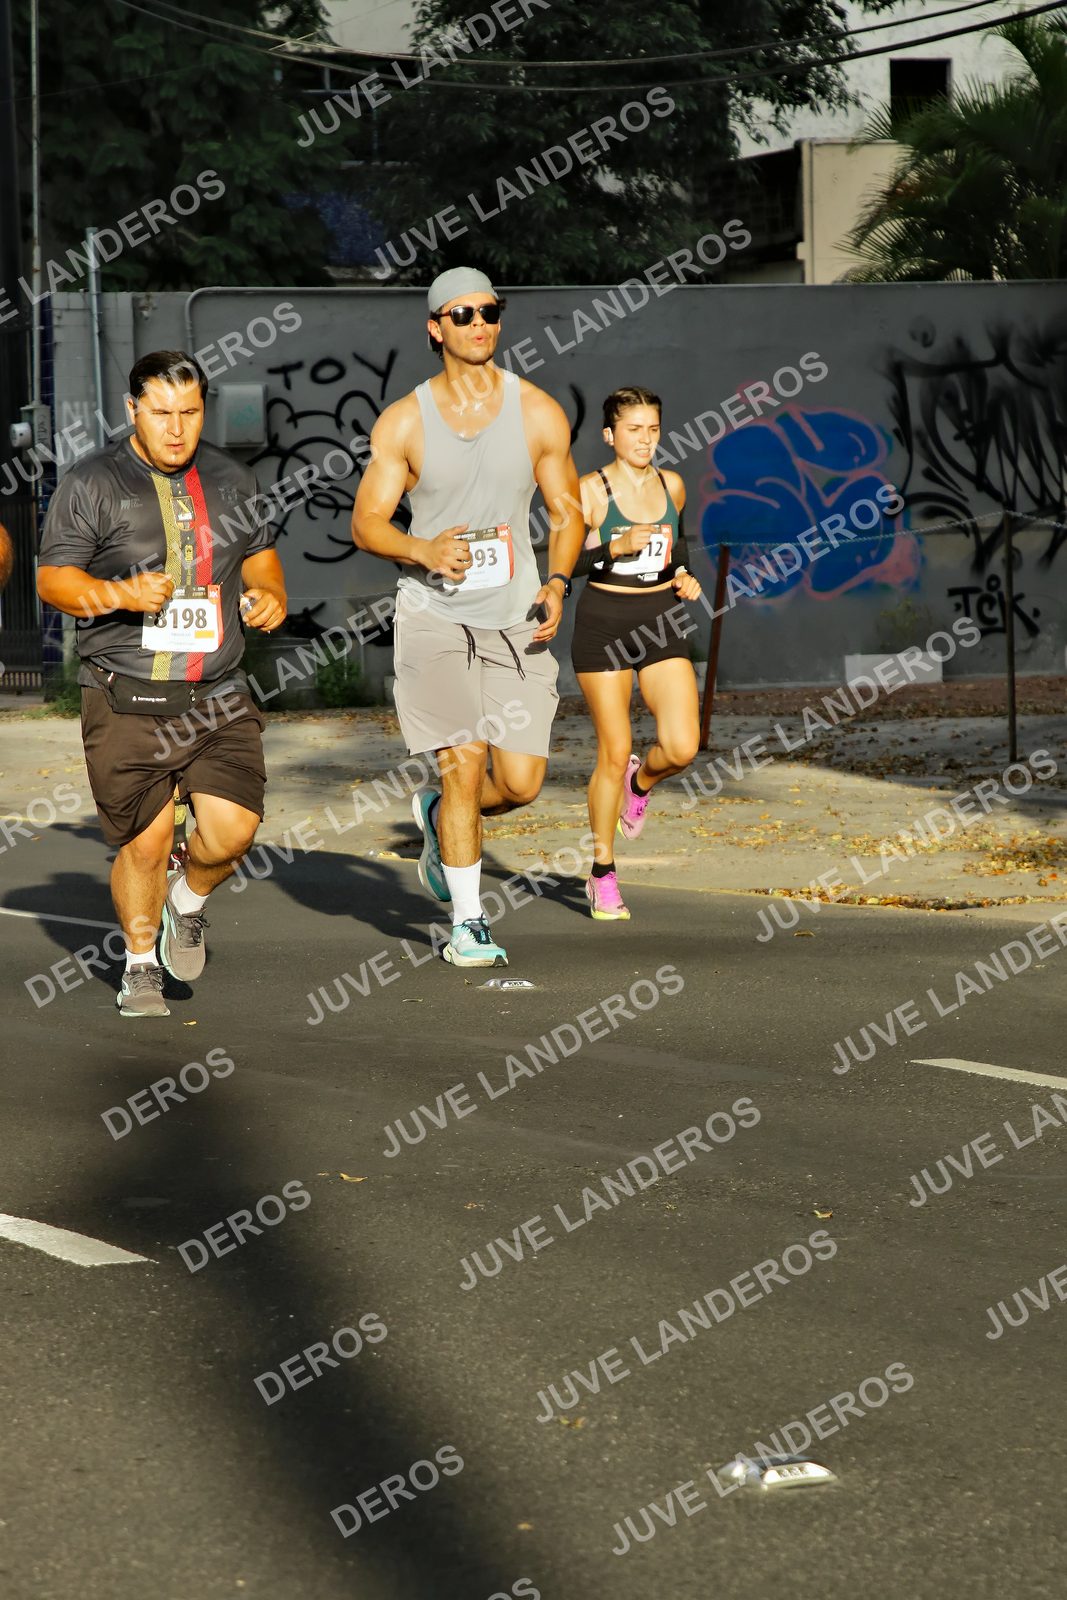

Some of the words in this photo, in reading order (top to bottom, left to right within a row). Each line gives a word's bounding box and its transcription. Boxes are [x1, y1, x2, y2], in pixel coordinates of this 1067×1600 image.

[267, 348, 397, 400] TOY
[474, 547, 498, 568] 93
[647, 541, 663, 557] 12
